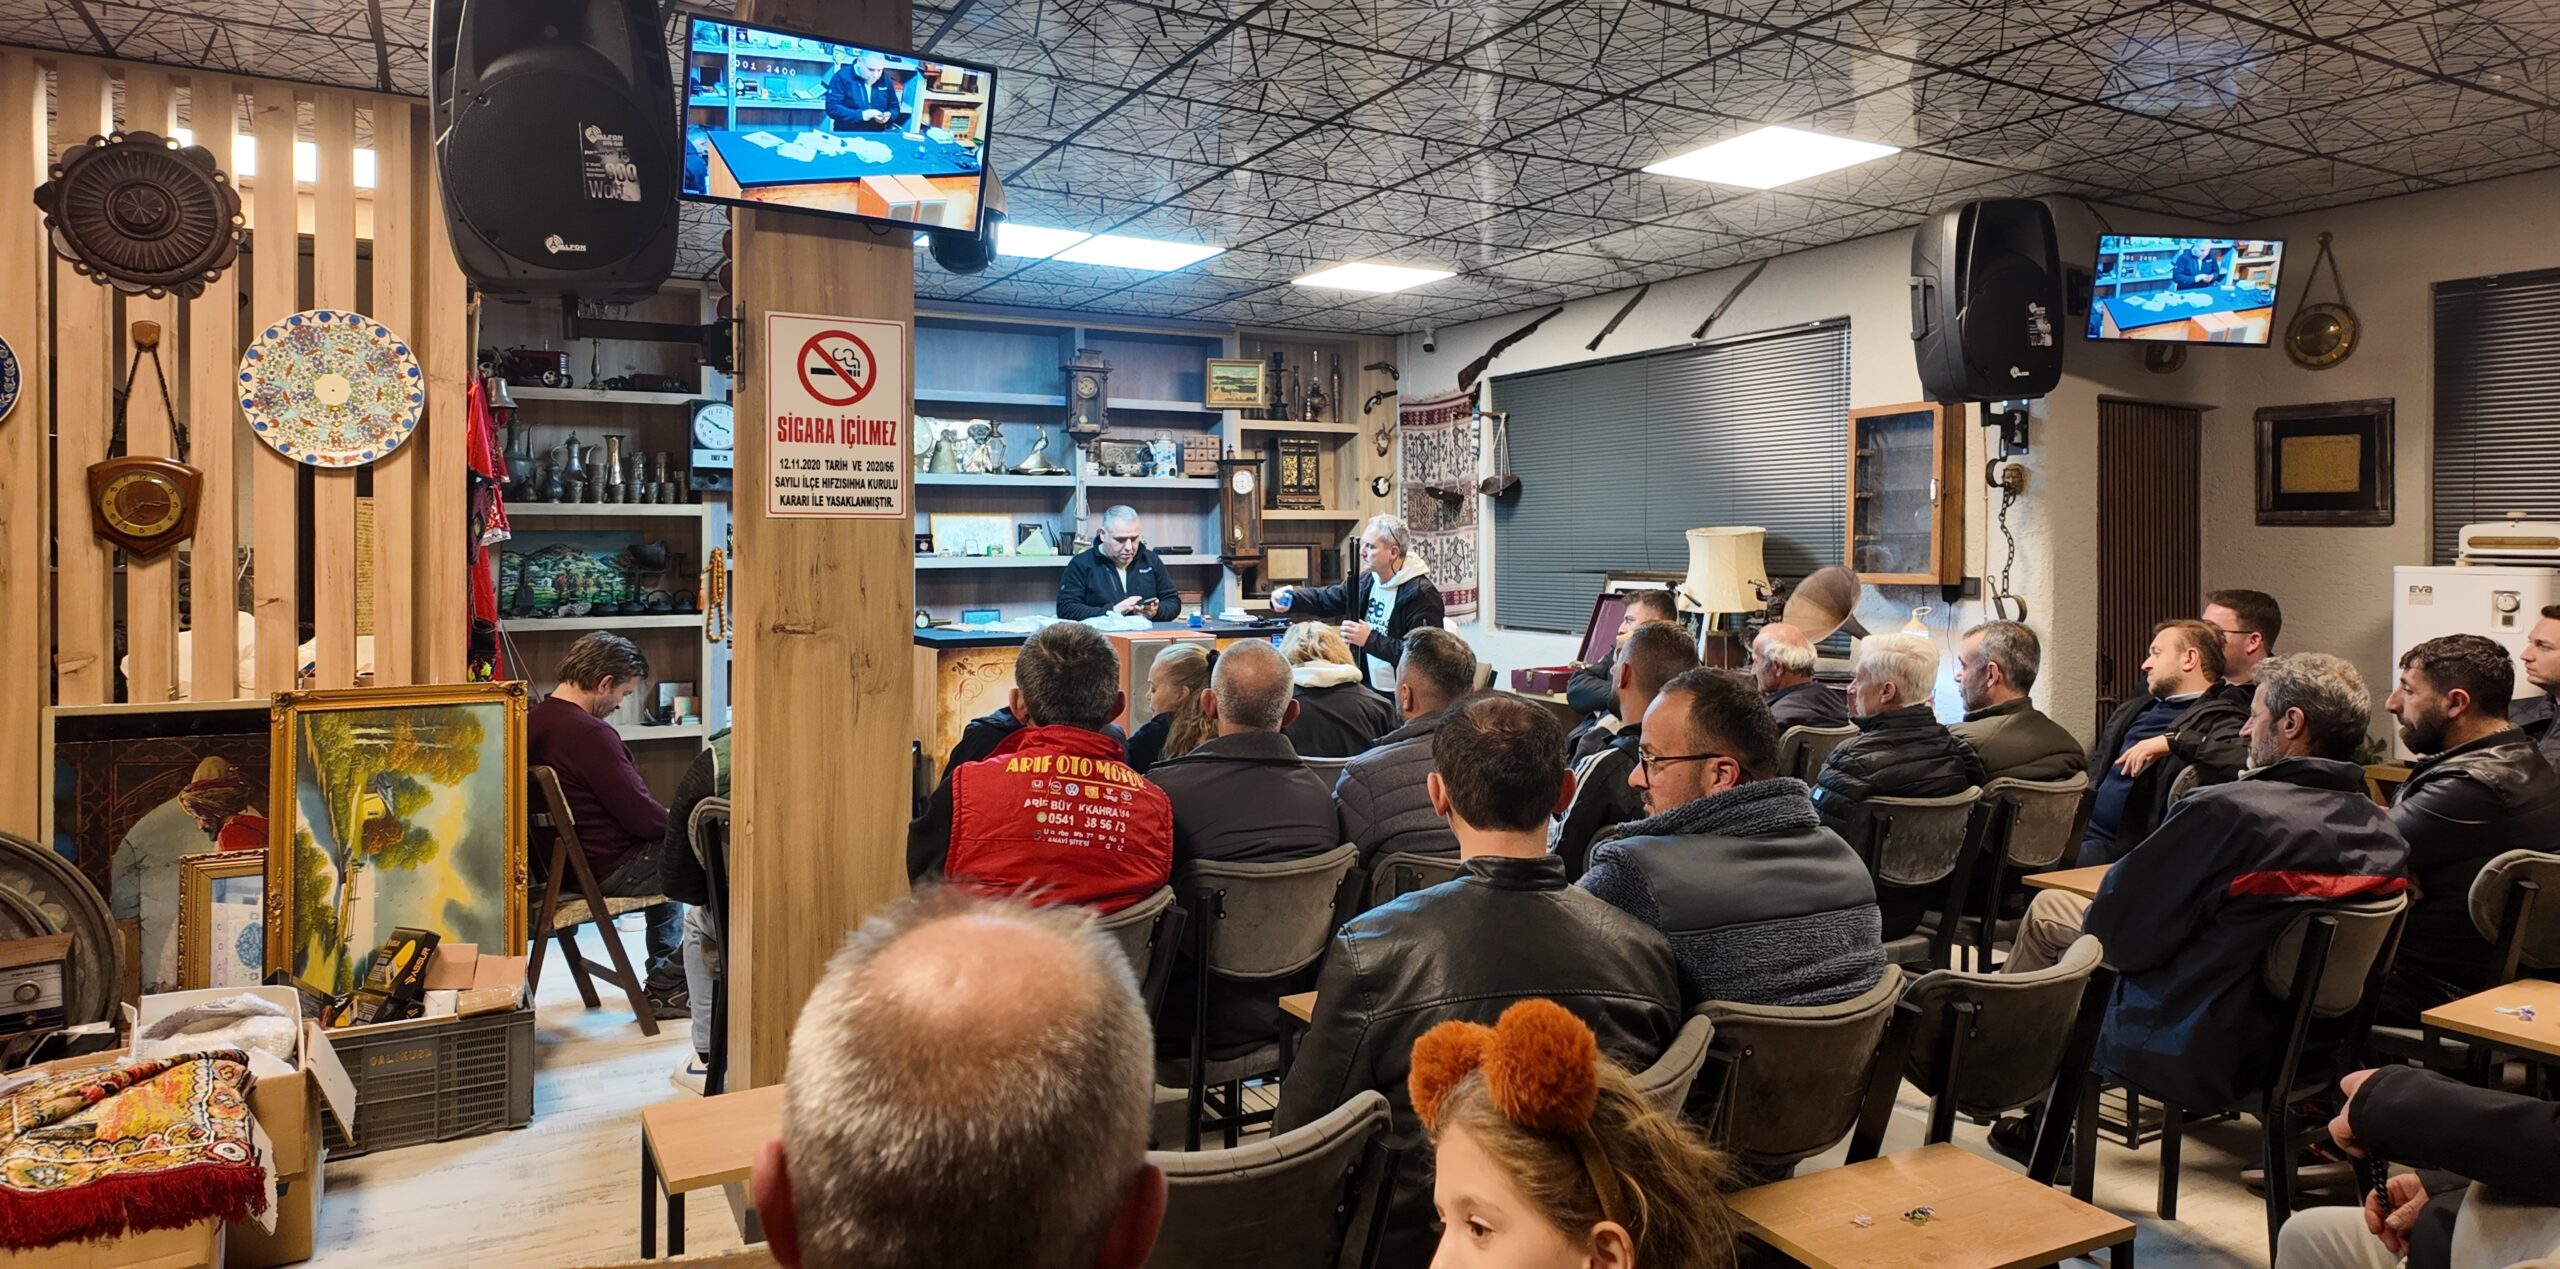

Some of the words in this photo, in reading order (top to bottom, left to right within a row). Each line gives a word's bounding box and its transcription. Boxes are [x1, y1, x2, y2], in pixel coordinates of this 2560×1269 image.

[777, 412, 835, 444] SİGARA
[841, 414, 897, 449] İÇİLMEZ
[780, 458, 821, 470] 12.11.2020
[825, 457, 848, 471] TARİH
[852, 460, 862, 472] VE
[866, 460, 894, 472] 2020/66
[775, 476, 800, 488] SAYILI
[802, 474, 819, 491] İLÇE
[867, 478, 898, 490] KURULU
[780, 494, 809, 507] KARARI
[812, 493, 824, 507] İLE
[826, 495, 894, 511] YASAKLANMIŞTIR.
[1006, 755, 1052, 773] ARIF
[1056, 755, 1093, 777] OTO
[1096, 760, 1147, 789] MOTOR
[1048, 813, 1075, 826] 0541
[1100, 819, 1112, 831] 56
[411, 946, 431, 977] ASSUR
